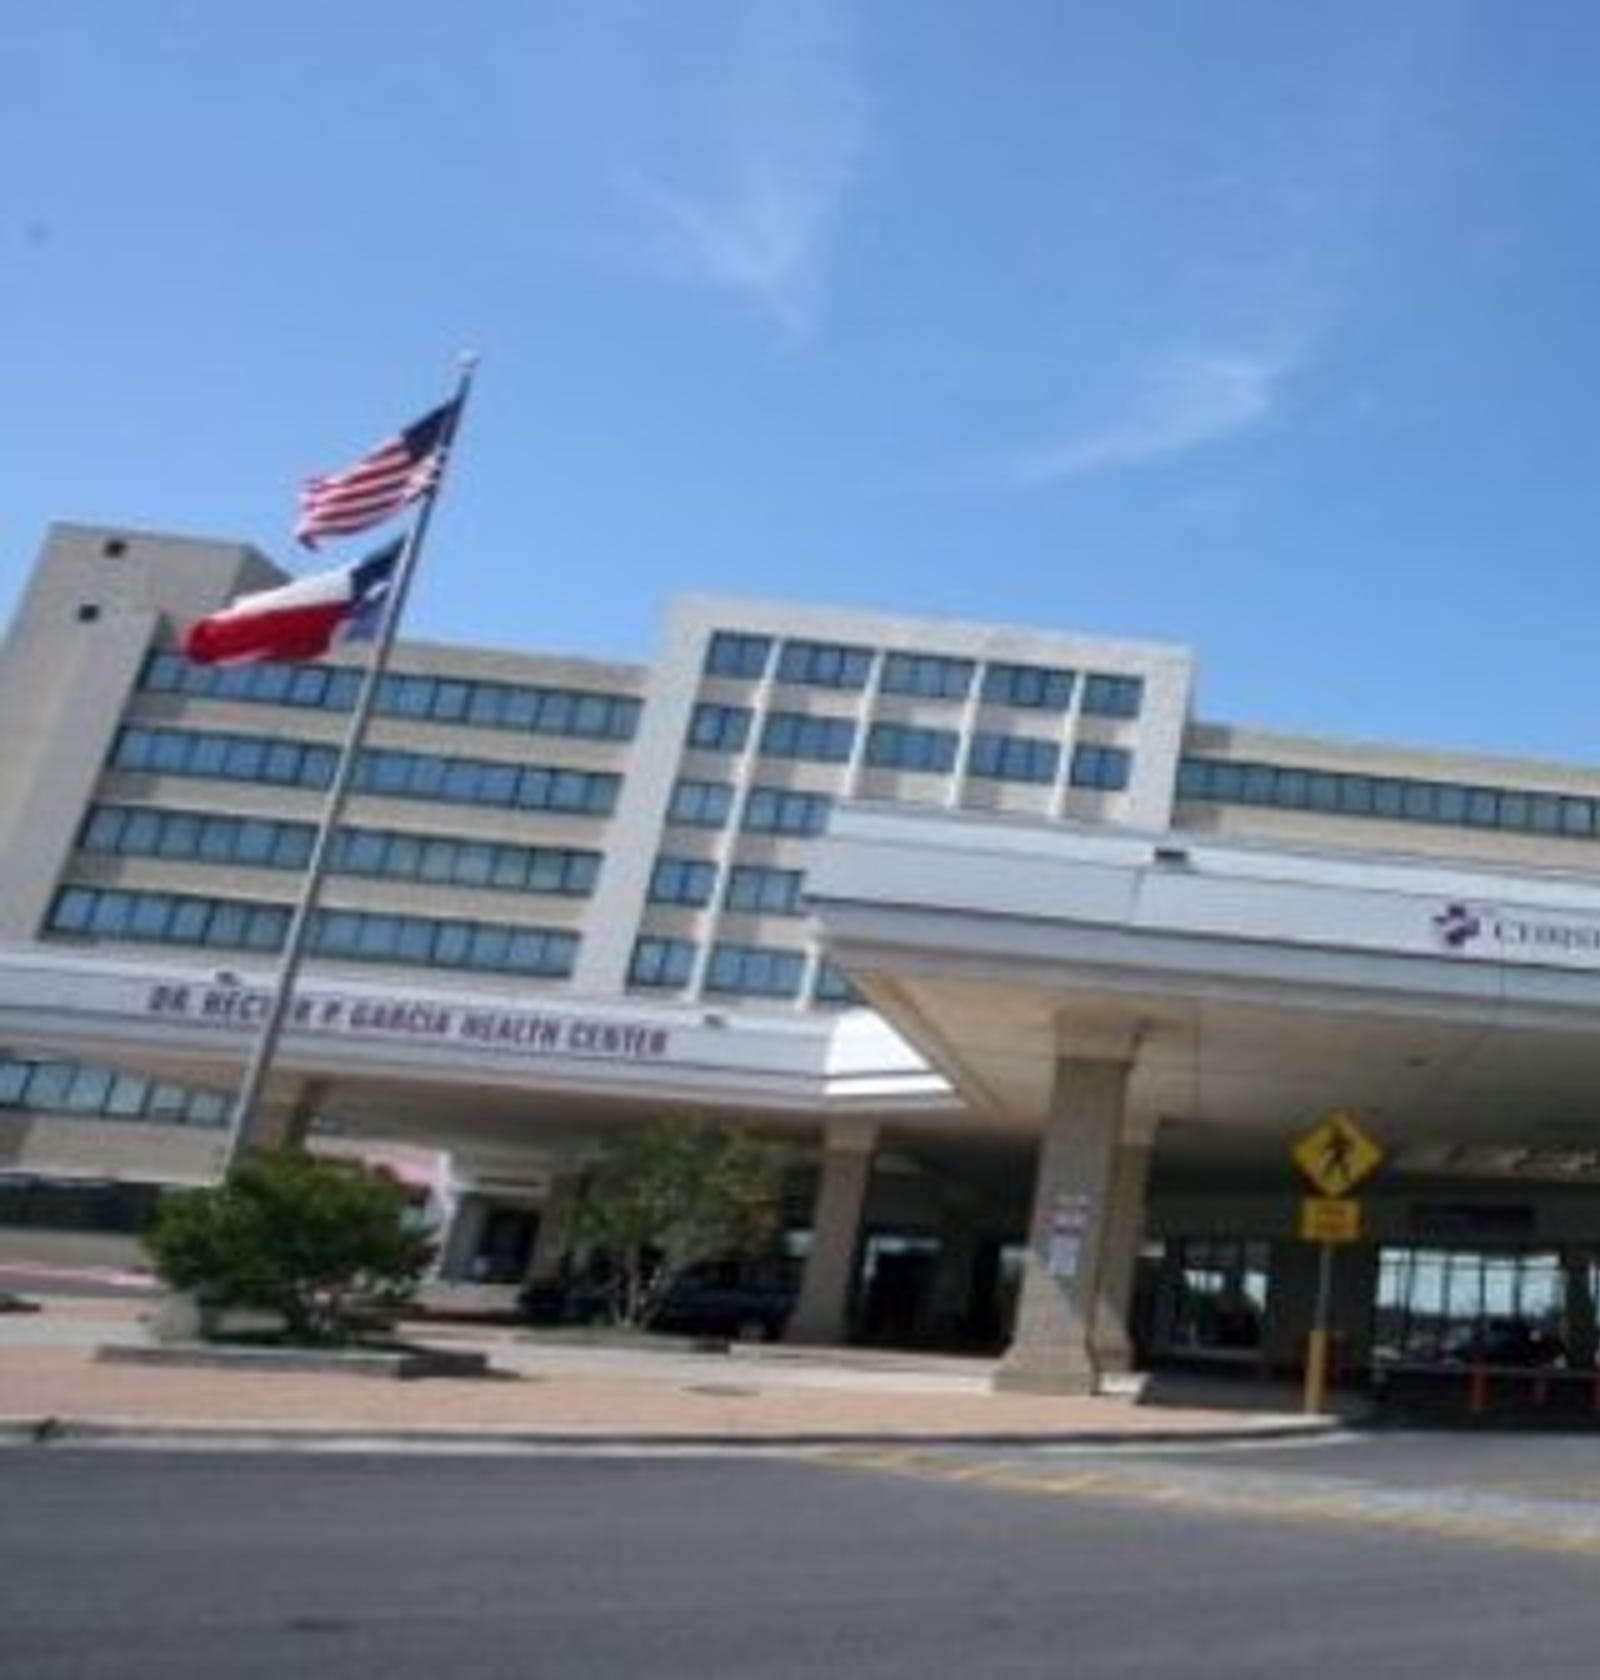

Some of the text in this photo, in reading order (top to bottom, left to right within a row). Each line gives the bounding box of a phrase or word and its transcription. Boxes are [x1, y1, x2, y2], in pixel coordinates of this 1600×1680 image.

[348, 1001, 450, 1036] GARCIA
[461, 1013, 561, 1045] HEALTH
[568, 1021, 668, 1054] CENTER
